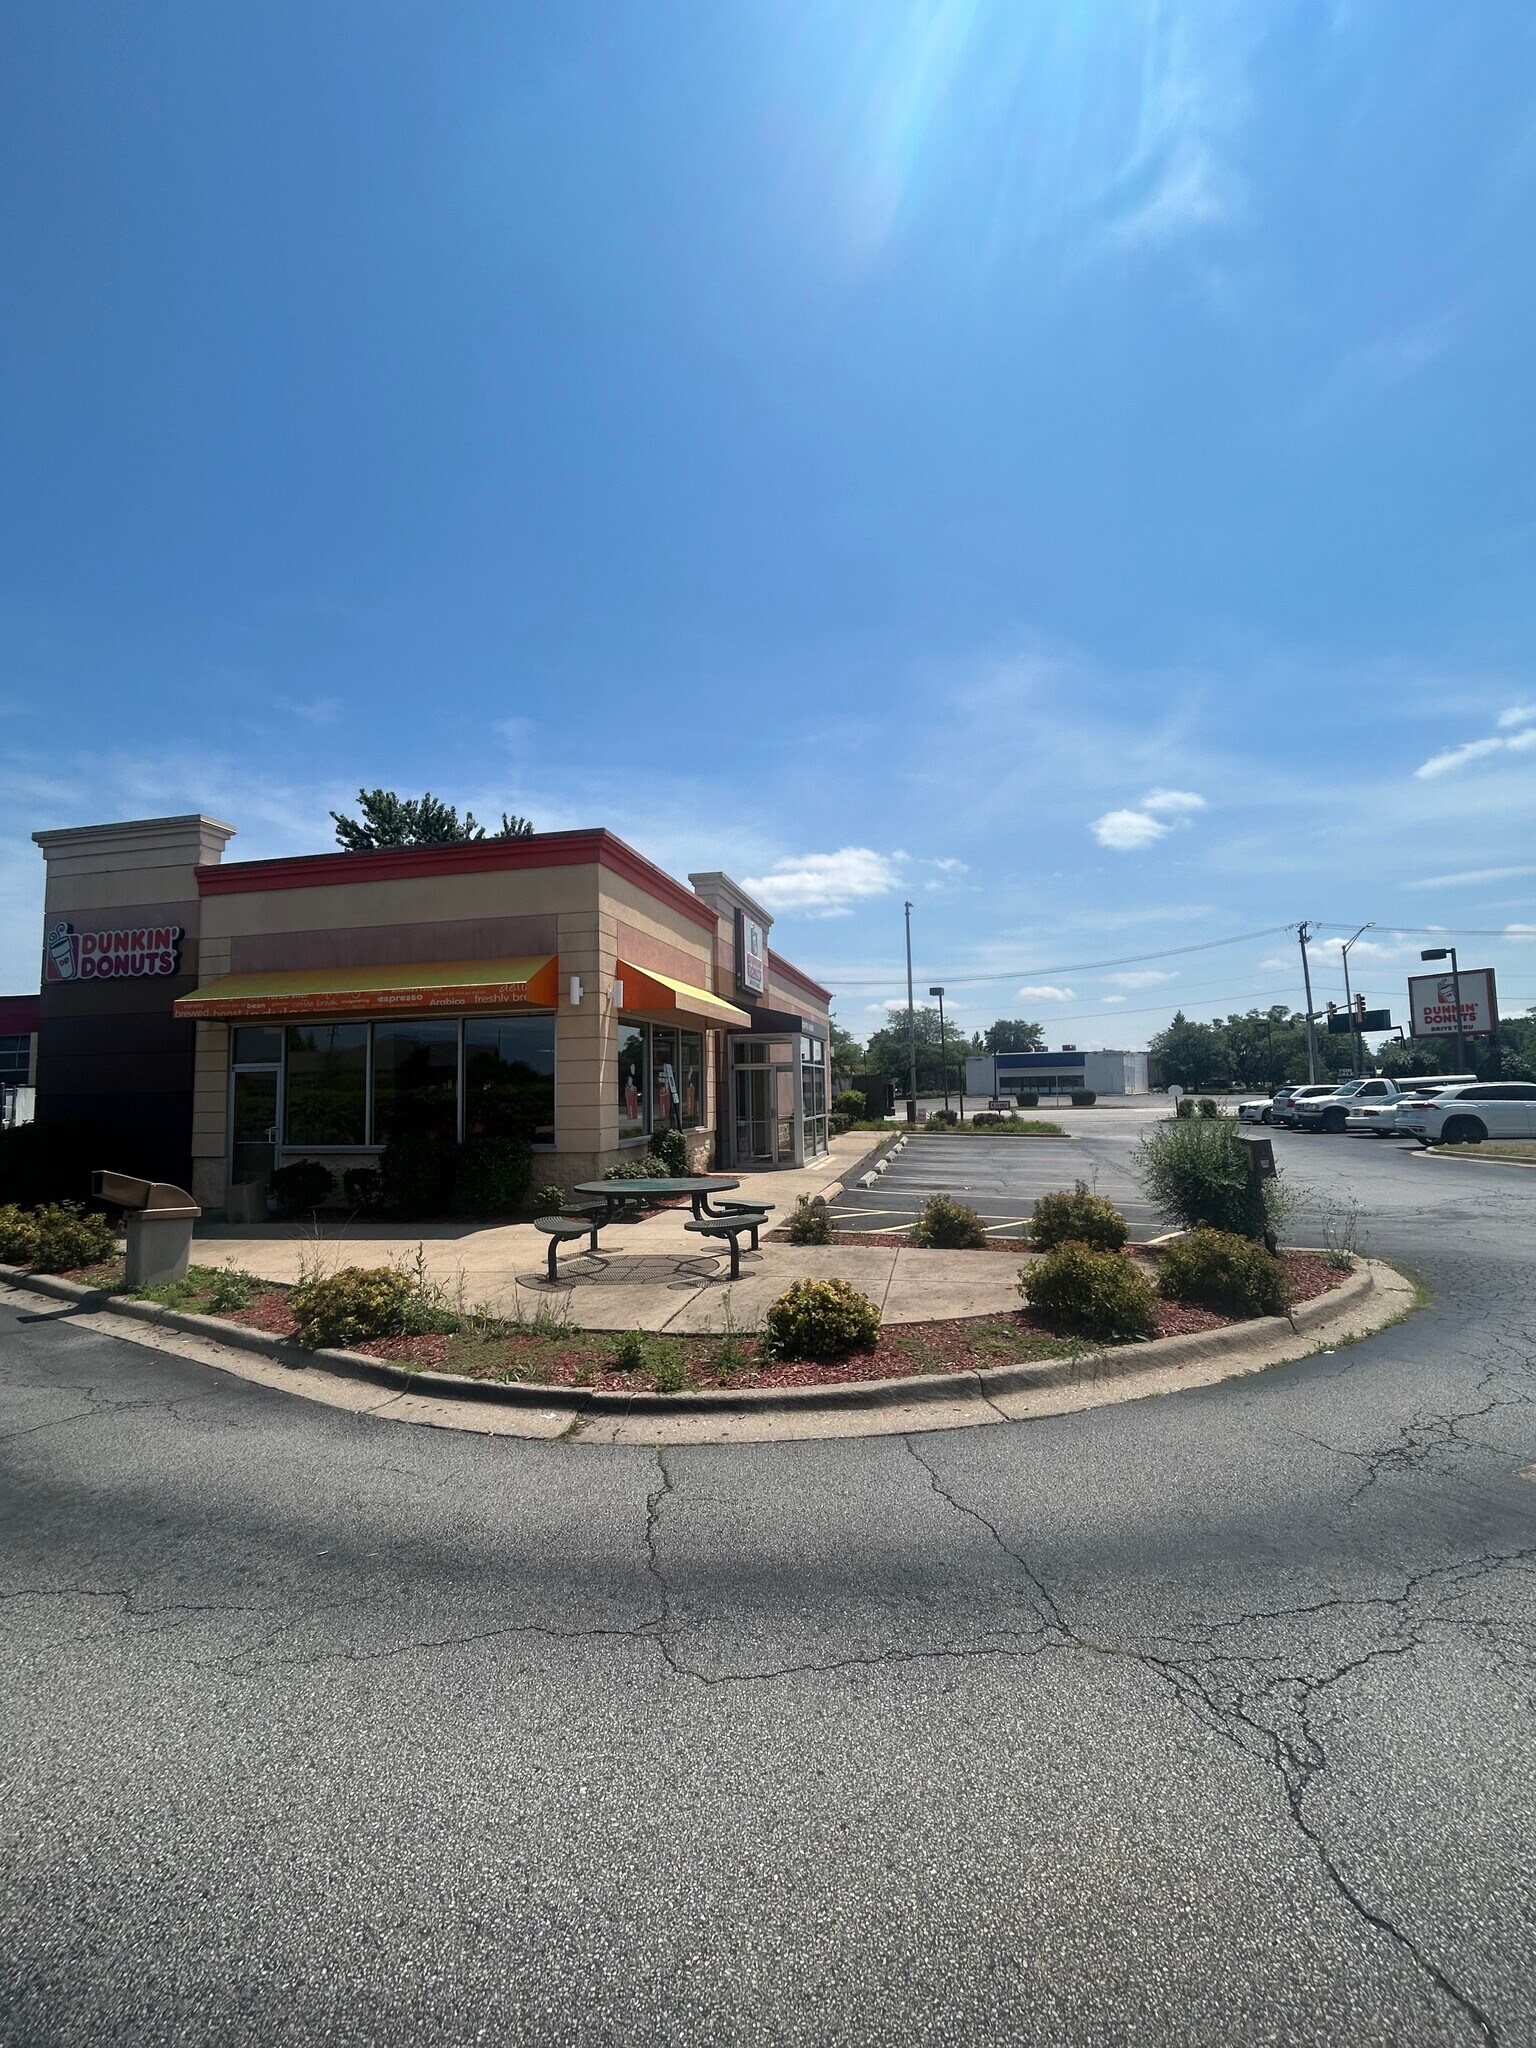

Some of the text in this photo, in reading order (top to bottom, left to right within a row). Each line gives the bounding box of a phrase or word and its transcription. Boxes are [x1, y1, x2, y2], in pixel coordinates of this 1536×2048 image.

[82, 927, 178, 954] DUNKIN'
[81, 952, 173, 977] DONUTS
[377, 993, 423, 1003] espresso
[429, 997, 466, 1007] Arabica
[474, 994, 509, 1003] freshly
[174, 1008, 210, 1018] brewed
